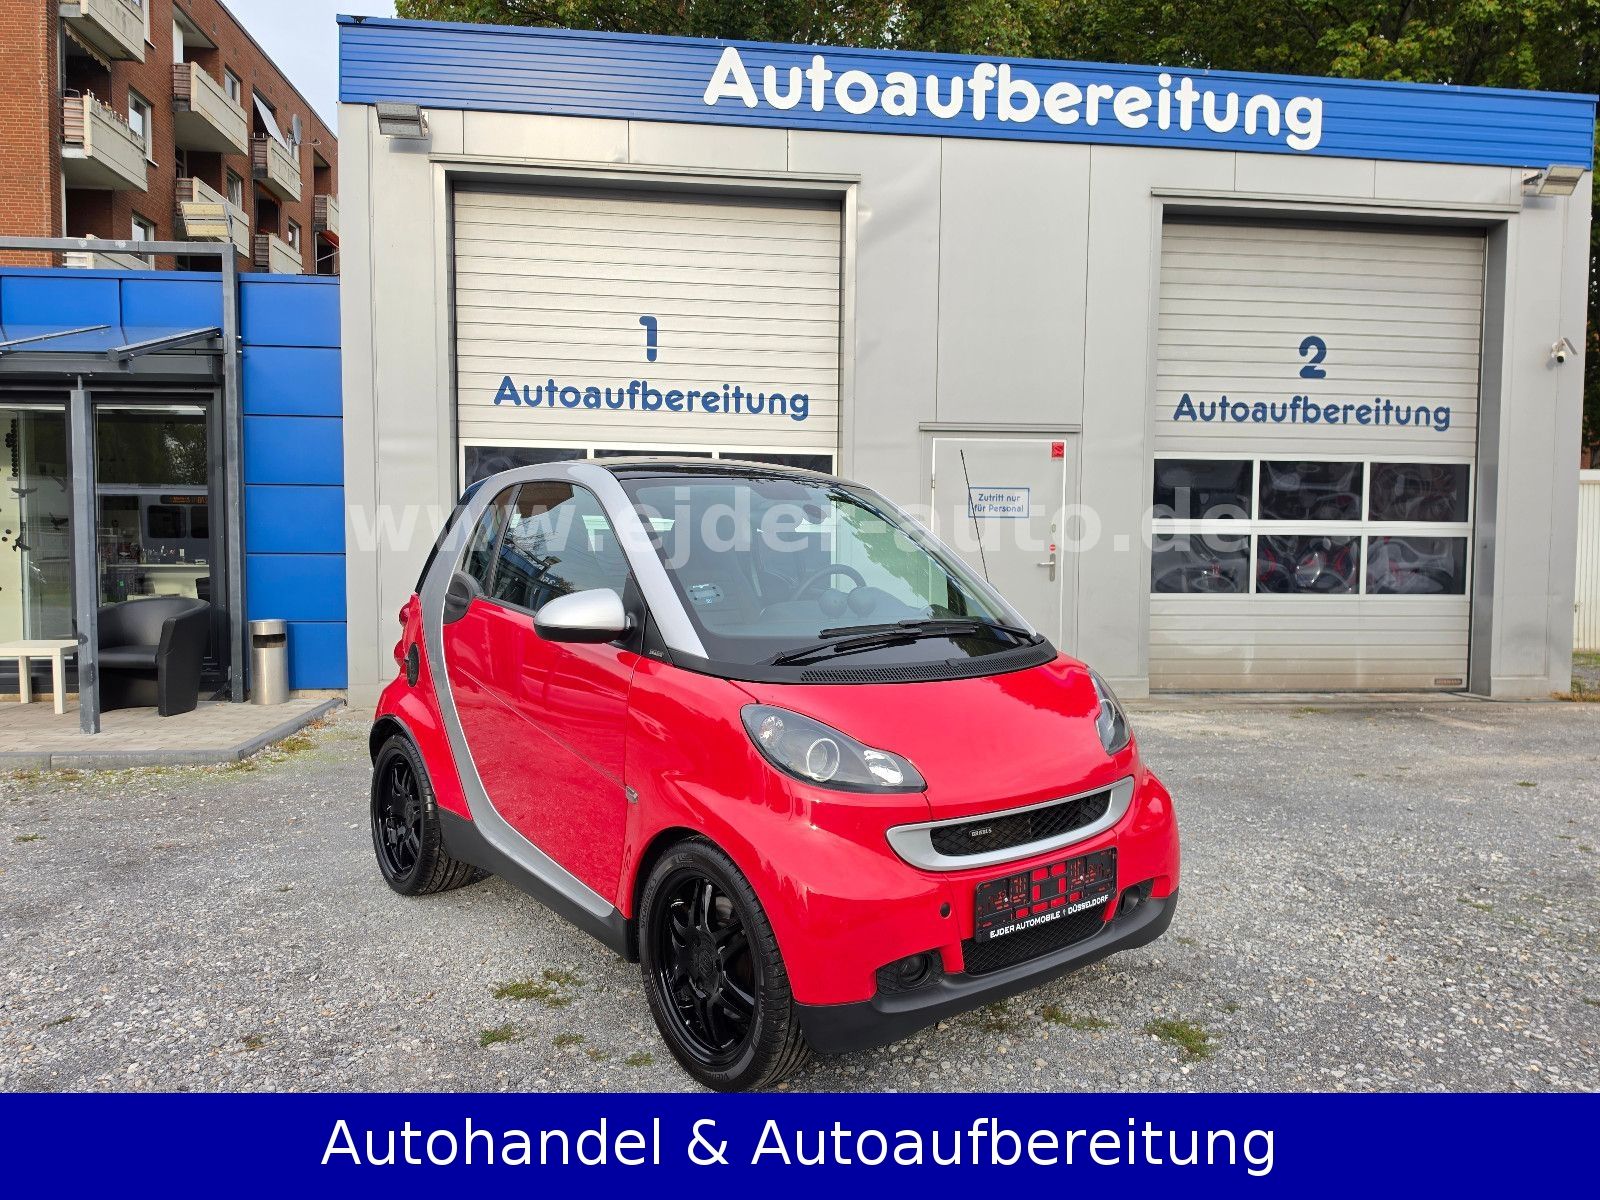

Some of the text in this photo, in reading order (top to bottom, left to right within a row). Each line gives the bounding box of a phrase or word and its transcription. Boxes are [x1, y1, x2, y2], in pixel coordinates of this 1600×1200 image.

[703, 46, 1323, 150] Autoaufbereitung
[639, 315, 657, 362] 1
[1299, 336, 1327, 379] 2
[494, 375, 809, 421] Autoaufbereitung
[1173, 393, 1451, 432] Autoaufbereitung
[974, 504, 1024, 512] für Personal
[978, 493, 1004, 502] Zutritt
[989, 894, 1109, 939] EJDER AUTOMOBILE DÜSSELDORF
